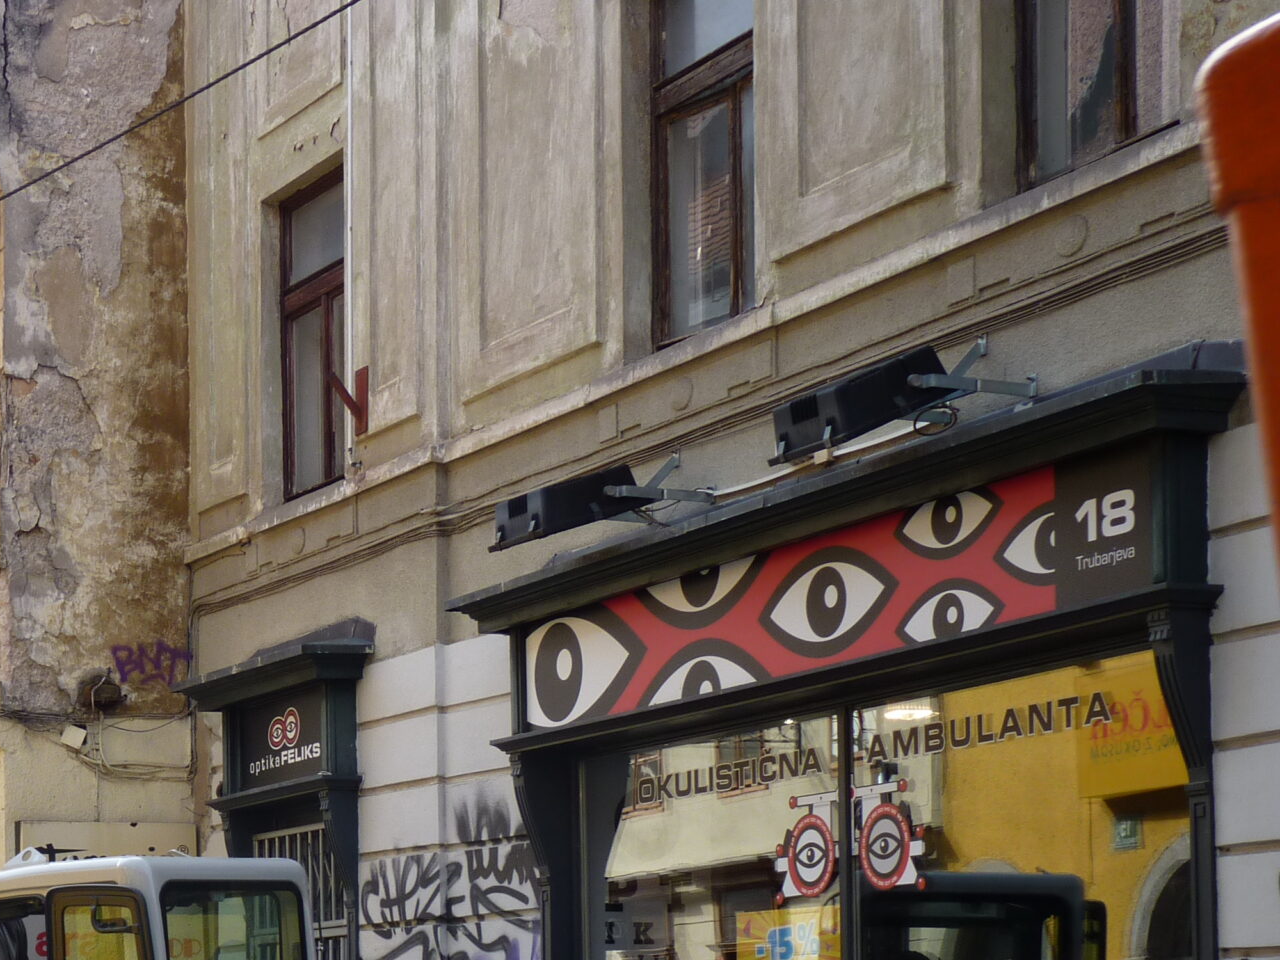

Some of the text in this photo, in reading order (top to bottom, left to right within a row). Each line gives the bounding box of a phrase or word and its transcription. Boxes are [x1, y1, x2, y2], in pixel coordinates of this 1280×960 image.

[1075, 488, 1136, 542] 18
[1075, 546, 1135, 571] Trubarjeva
[637, 691, 1113, 804] OKULISTIČNA AMBULANTA
